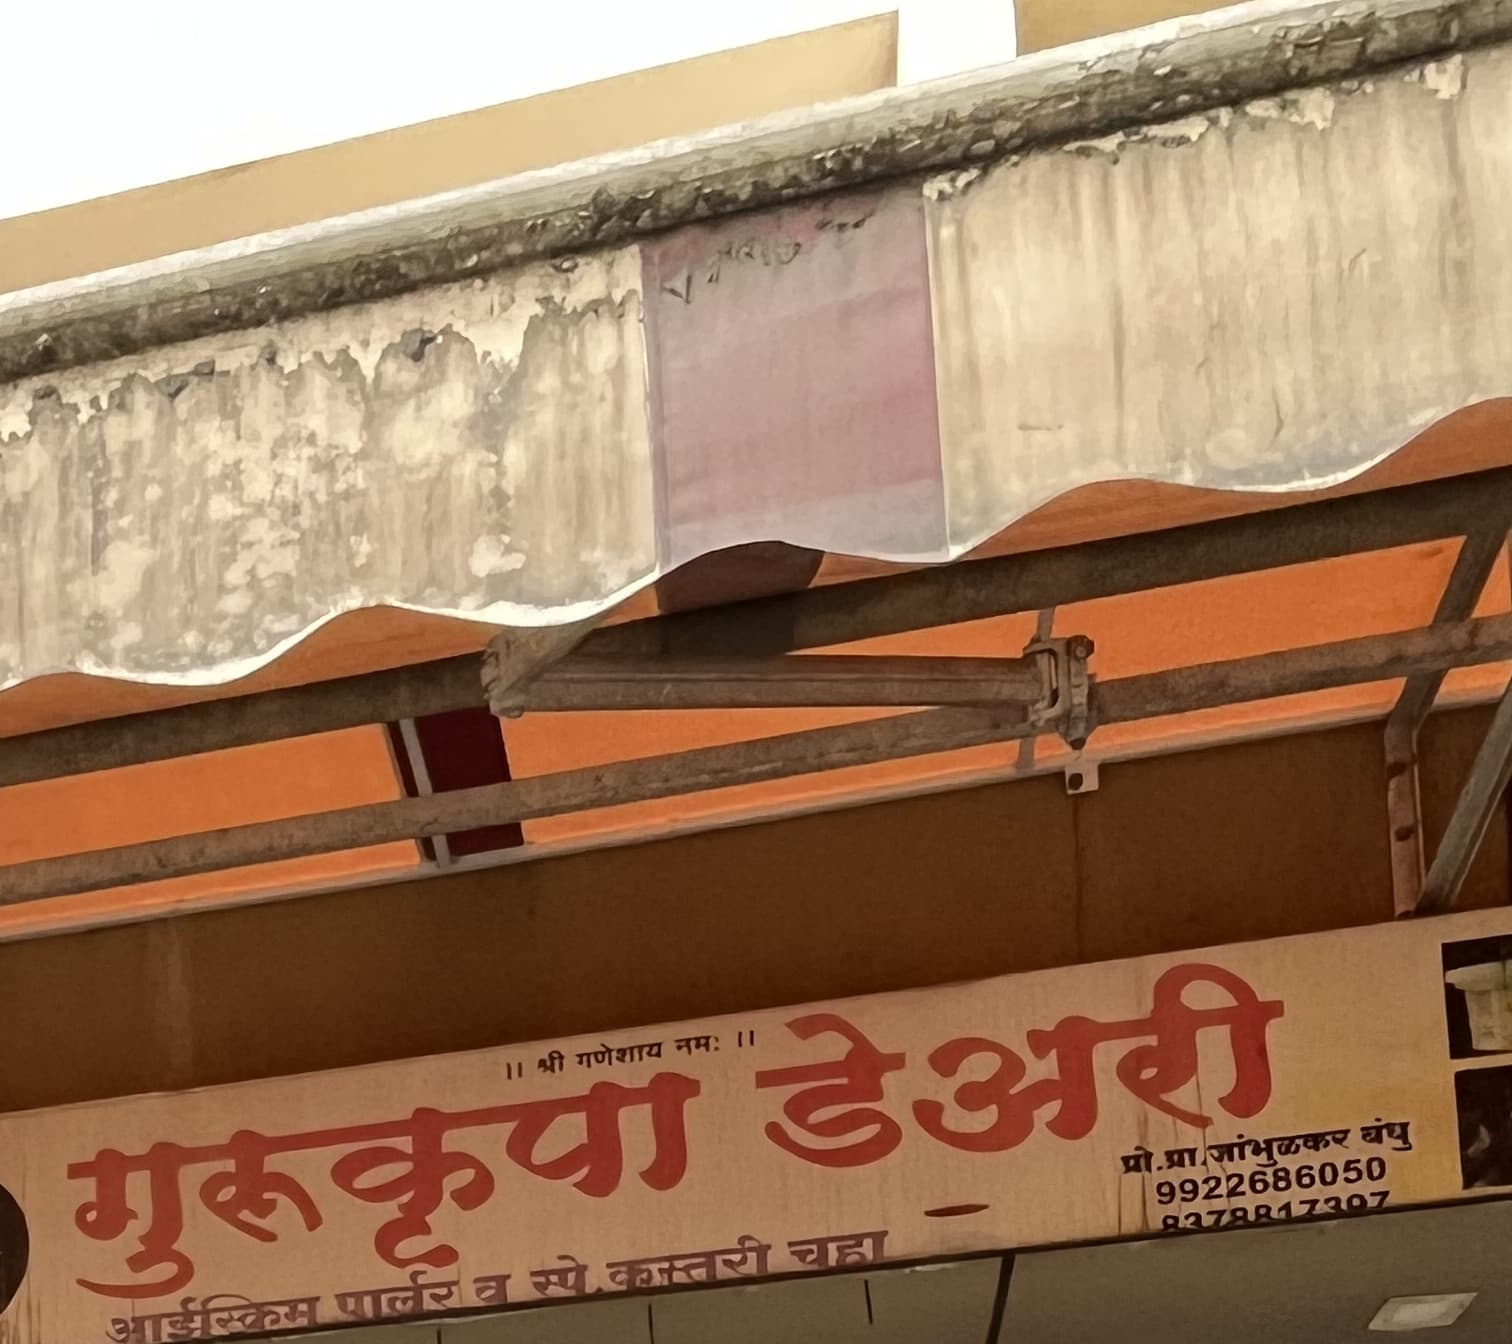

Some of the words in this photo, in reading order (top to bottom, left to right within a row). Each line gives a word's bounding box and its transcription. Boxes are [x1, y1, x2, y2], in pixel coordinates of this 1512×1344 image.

[537, 1050, 565, 1074] श्री
[576, 1043, 663, 1069] गणेशाय
[756, 962, 1285, 1169] डेअरी
[1156, 1156, 1387, 1205] 9922686050
[474, 1273, 512, 1304] व
